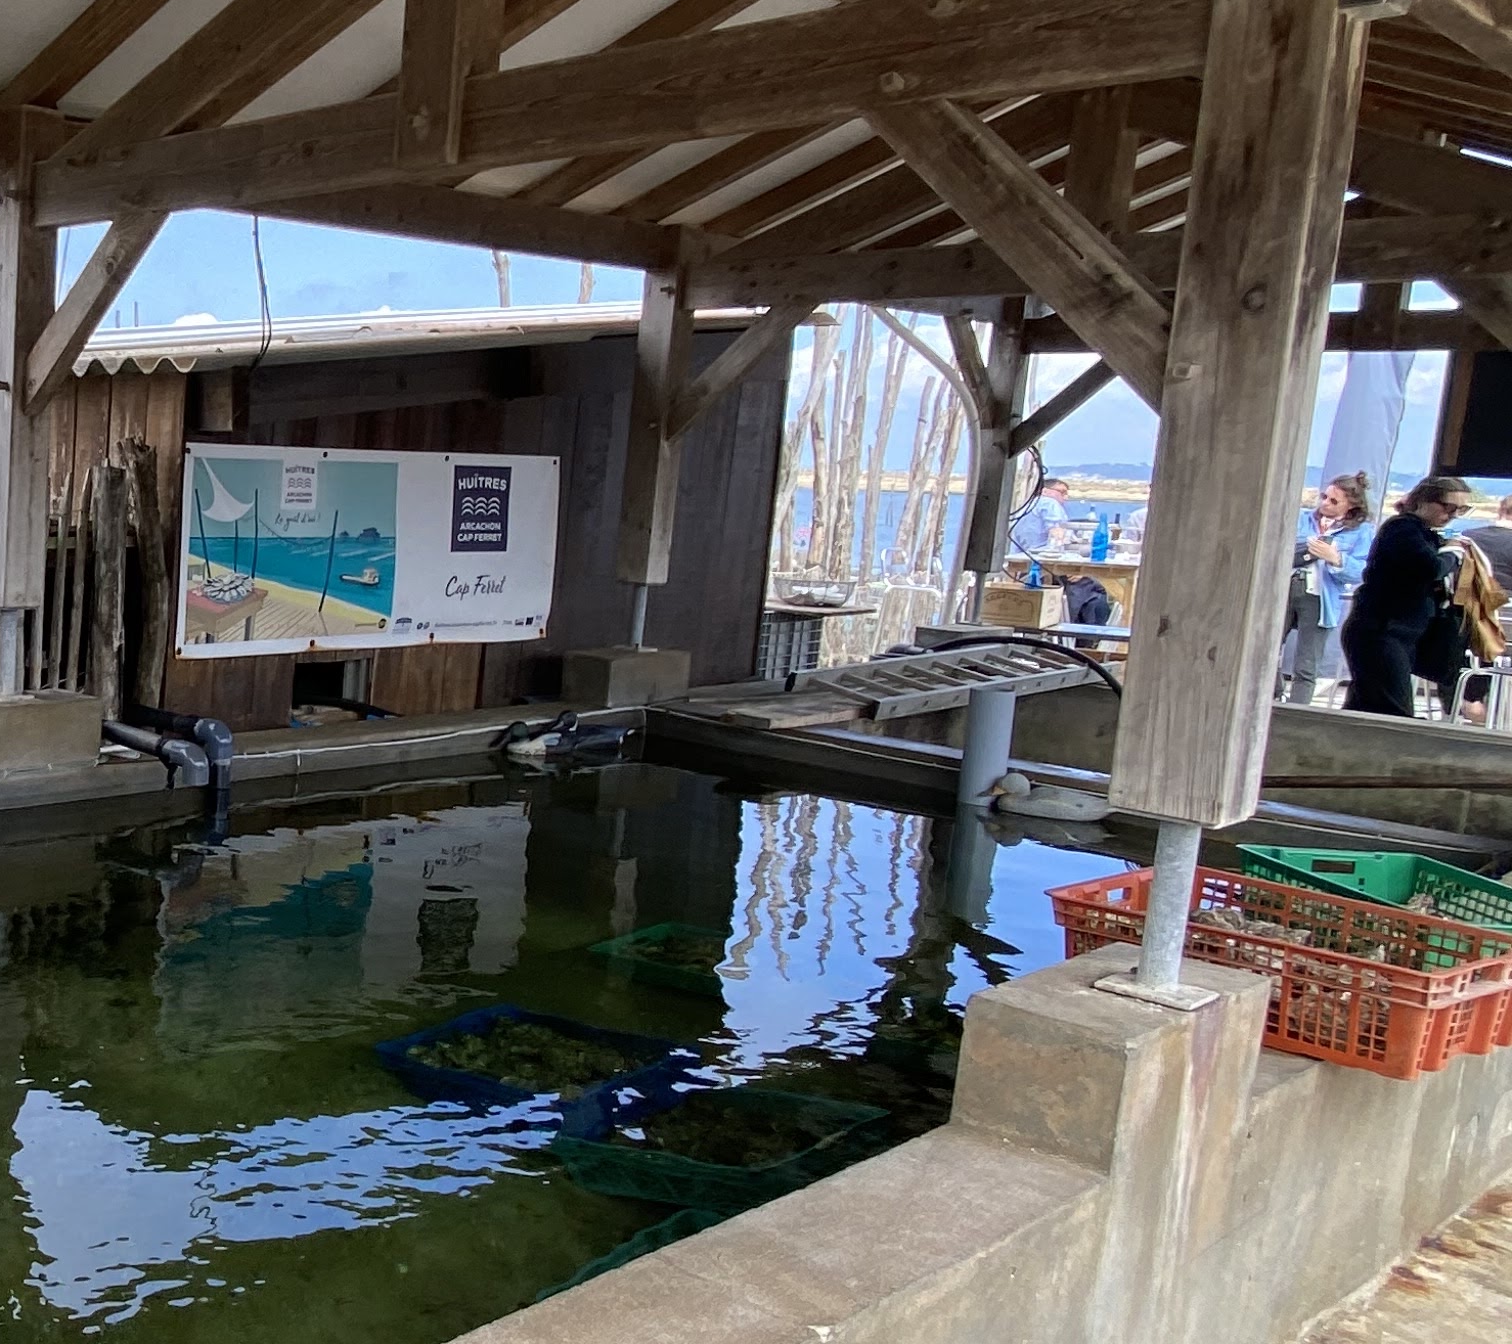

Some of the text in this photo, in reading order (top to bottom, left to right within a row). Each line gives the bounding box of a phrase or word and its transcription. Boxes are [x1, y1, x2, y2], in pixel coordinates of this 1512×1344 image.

[459, 522, 502, 531] ARCACHON
[457, 533, 502, 542] CAP FERRET
[445, 574, 506, 601] Cap Ferret
